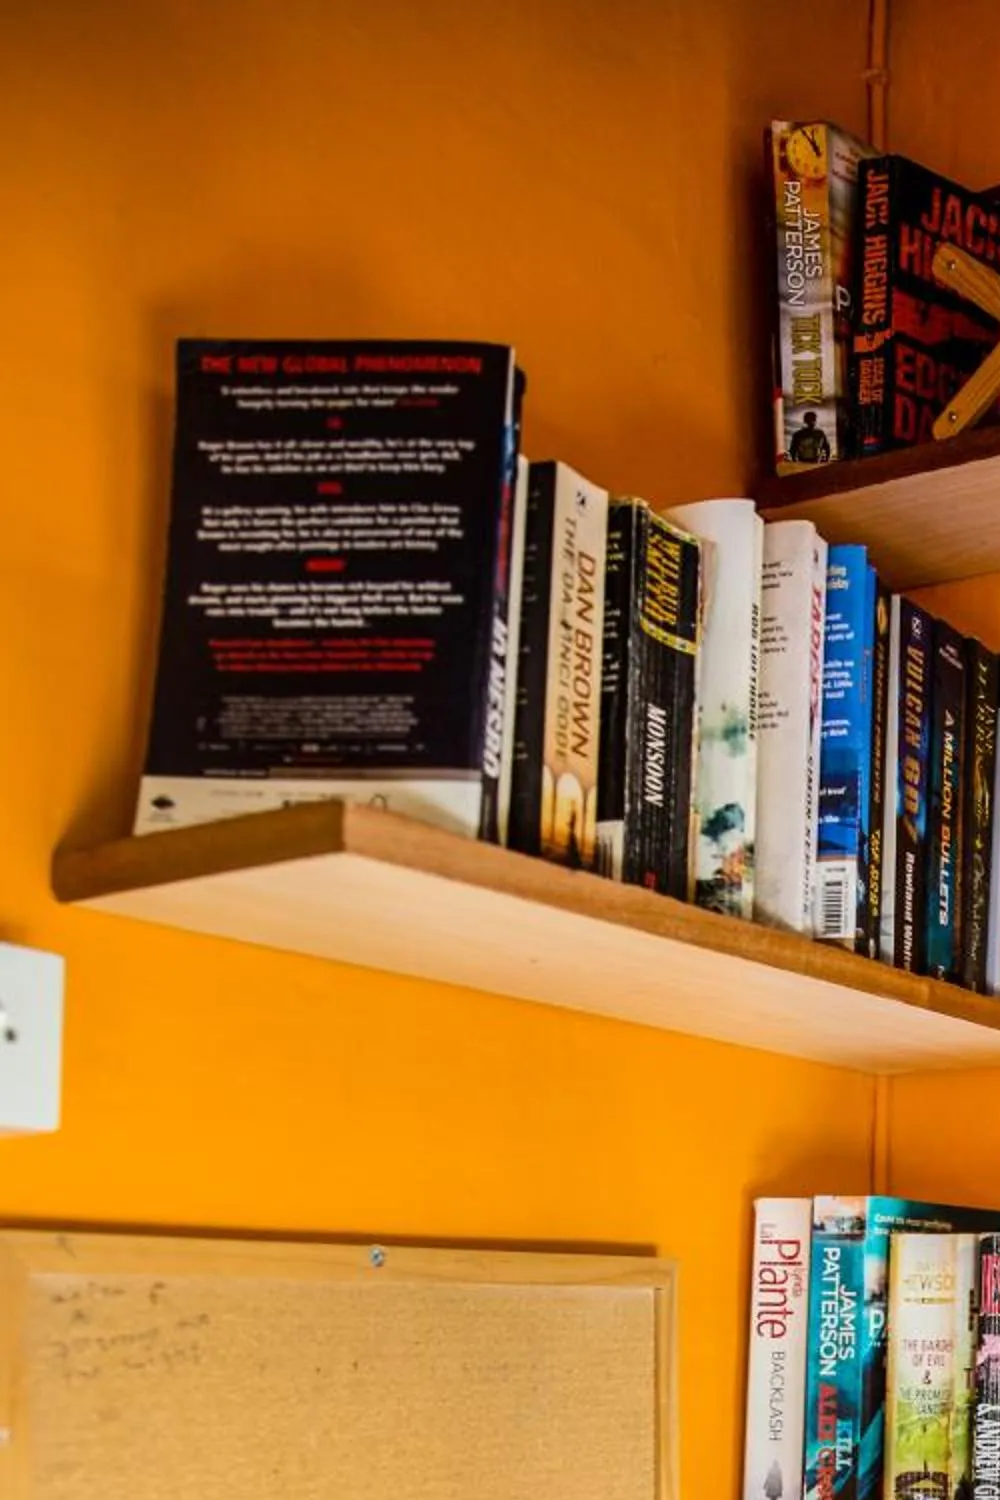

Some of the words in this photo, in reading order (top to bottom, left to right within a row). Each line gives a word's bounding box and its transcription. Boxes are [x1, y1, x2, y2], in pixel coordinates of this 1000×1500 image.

[783, 180, 805, 306] PATTERSON
[803, 208, 824, 278] JAMES
[865, 168, 889, 229] JACK
[863, 234, 888, 327] HIGGINS
[791, 313, 822, 356] TICK
[791, 357, 822, 405] TOCK
[576, 550, 597, 624] DAN
[570, 628, 595, 760] BROWN
[903, 646, 925, 748] VULCAN
[643, 702, 667, 809] MONSOON
[901, 754, 921, 844] 607
[941, 731, 955, 821] MILLION
[903, 851, 916, 922] Rowland
[938, 825, 953, 928] BULLETS
[757, 1239, 803, 1339] Plante
[818, 1247, 841, 1377] PATTERSON
[836, 1285, 857, 1361] JAMES
[768, 1350, 786, 1443] BACKLASH
[835, 1419, 853, 1472] KILL
[975, 1417, 1000, 1485] ANDREW
